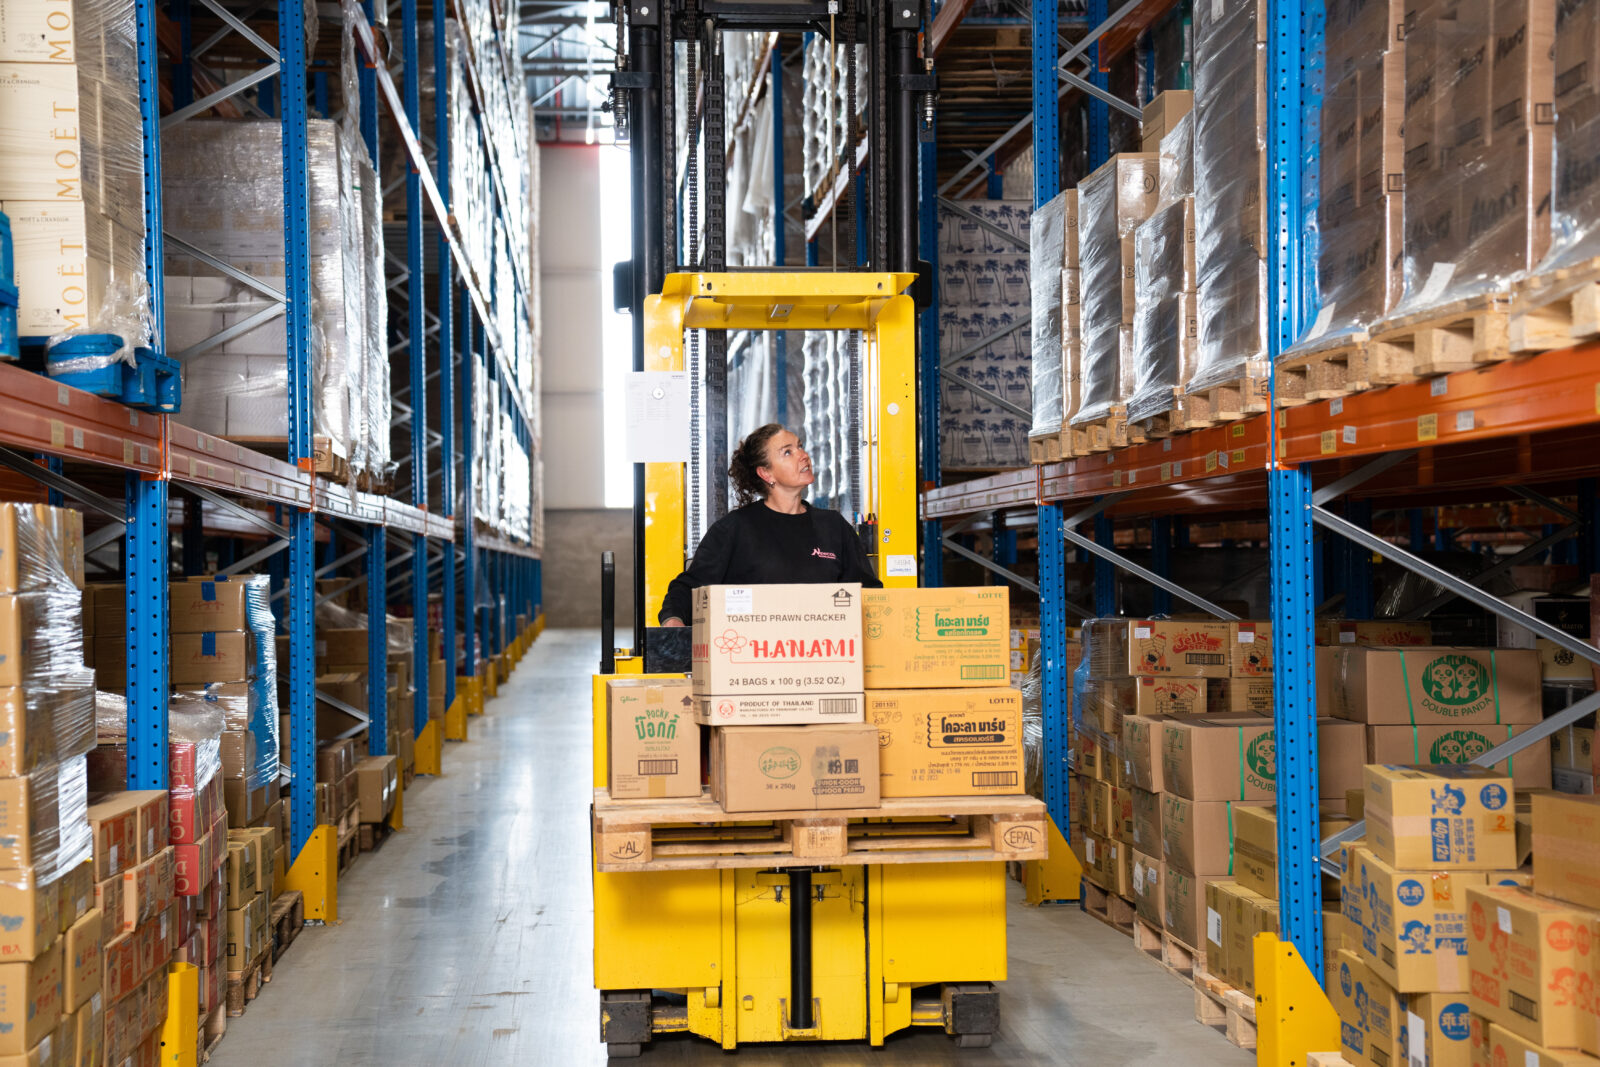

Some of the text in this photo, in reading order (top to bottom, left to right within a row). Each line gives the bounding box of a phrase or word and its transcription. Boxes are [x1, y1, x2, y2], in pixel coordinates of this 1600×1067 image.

[46, 0, 73, 61] MO
[49, 101, 80, 199] MOËT
[57, 238, 85, 333] MOËT
[726, 613, 846, 623] TOASTED PRAWN CRACKER
[749, 638, 855, 659] HANAMI
[729, 678, 740, 686] 24
[742, 677, 768, 686] BAGS
[778, 677, 794, 686] 100
[795, 678, 801, 687] g
[803, 676, 825, 687] (3.52
[826, 675, 846, 687] OZ.)
[1421, 697, 1493, 717] DOUBLE PANDA
[1246, 774, 1277, 793] DOUBL
[1010, 831, 1037, 844] EPAL
